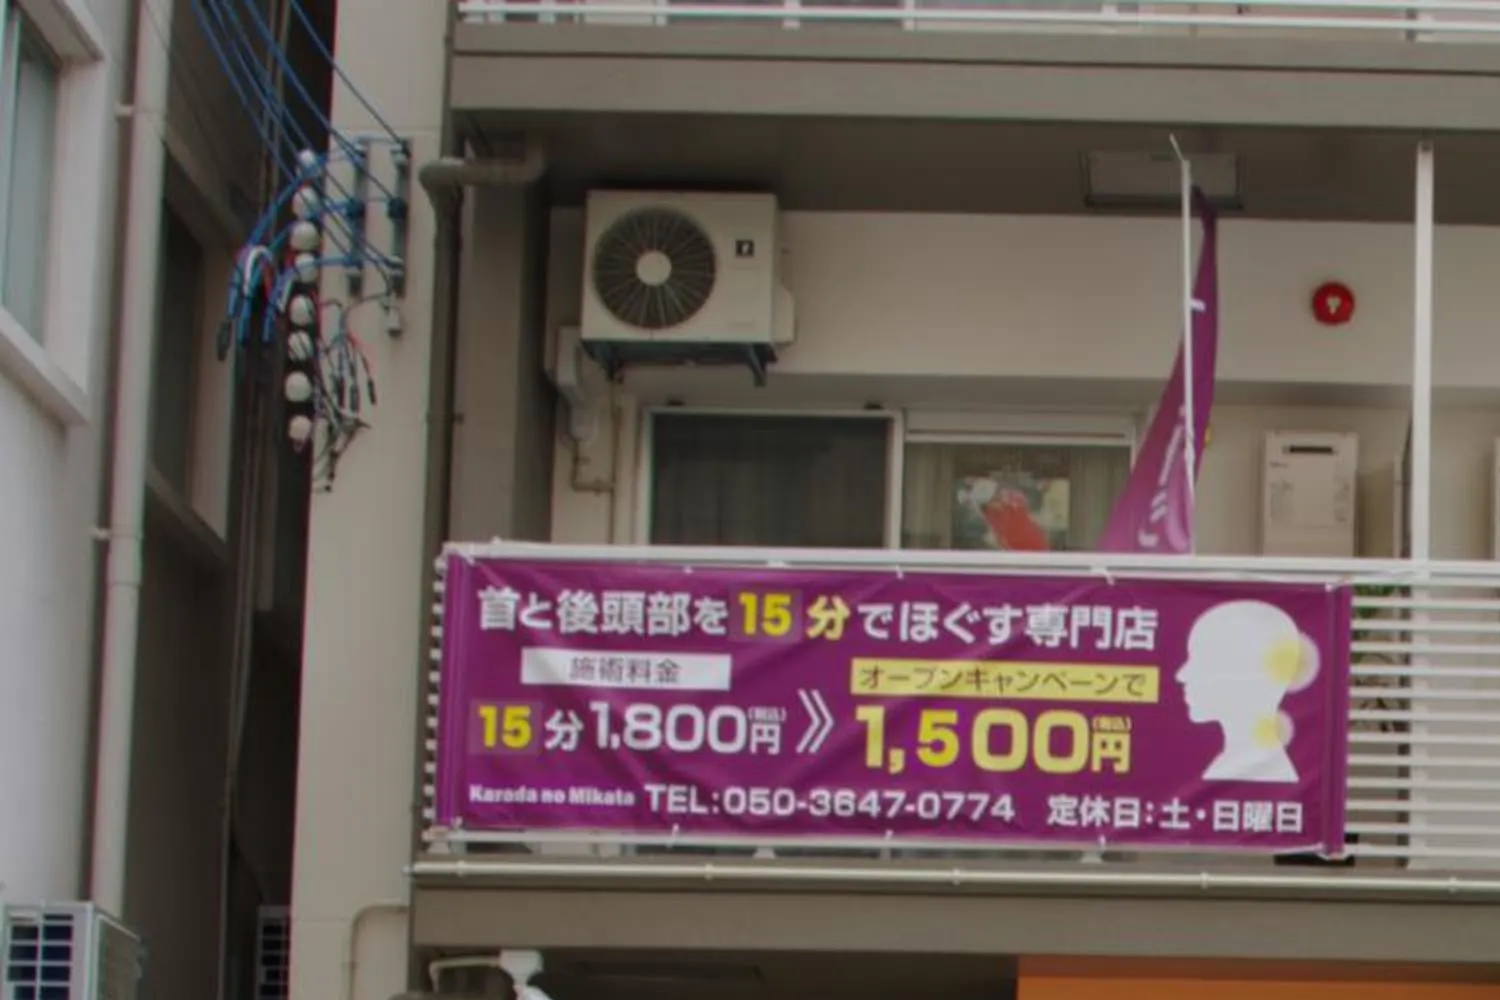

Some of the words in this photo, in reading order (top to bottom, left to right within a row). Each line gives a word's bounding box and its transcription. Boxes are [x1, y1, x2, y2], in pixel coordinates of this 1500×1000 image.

[569, 654, 682, 684] 施術料金
[859, 664, 1147, 697] オープンキャンペーンで
[541, 789, 566, 805] no
